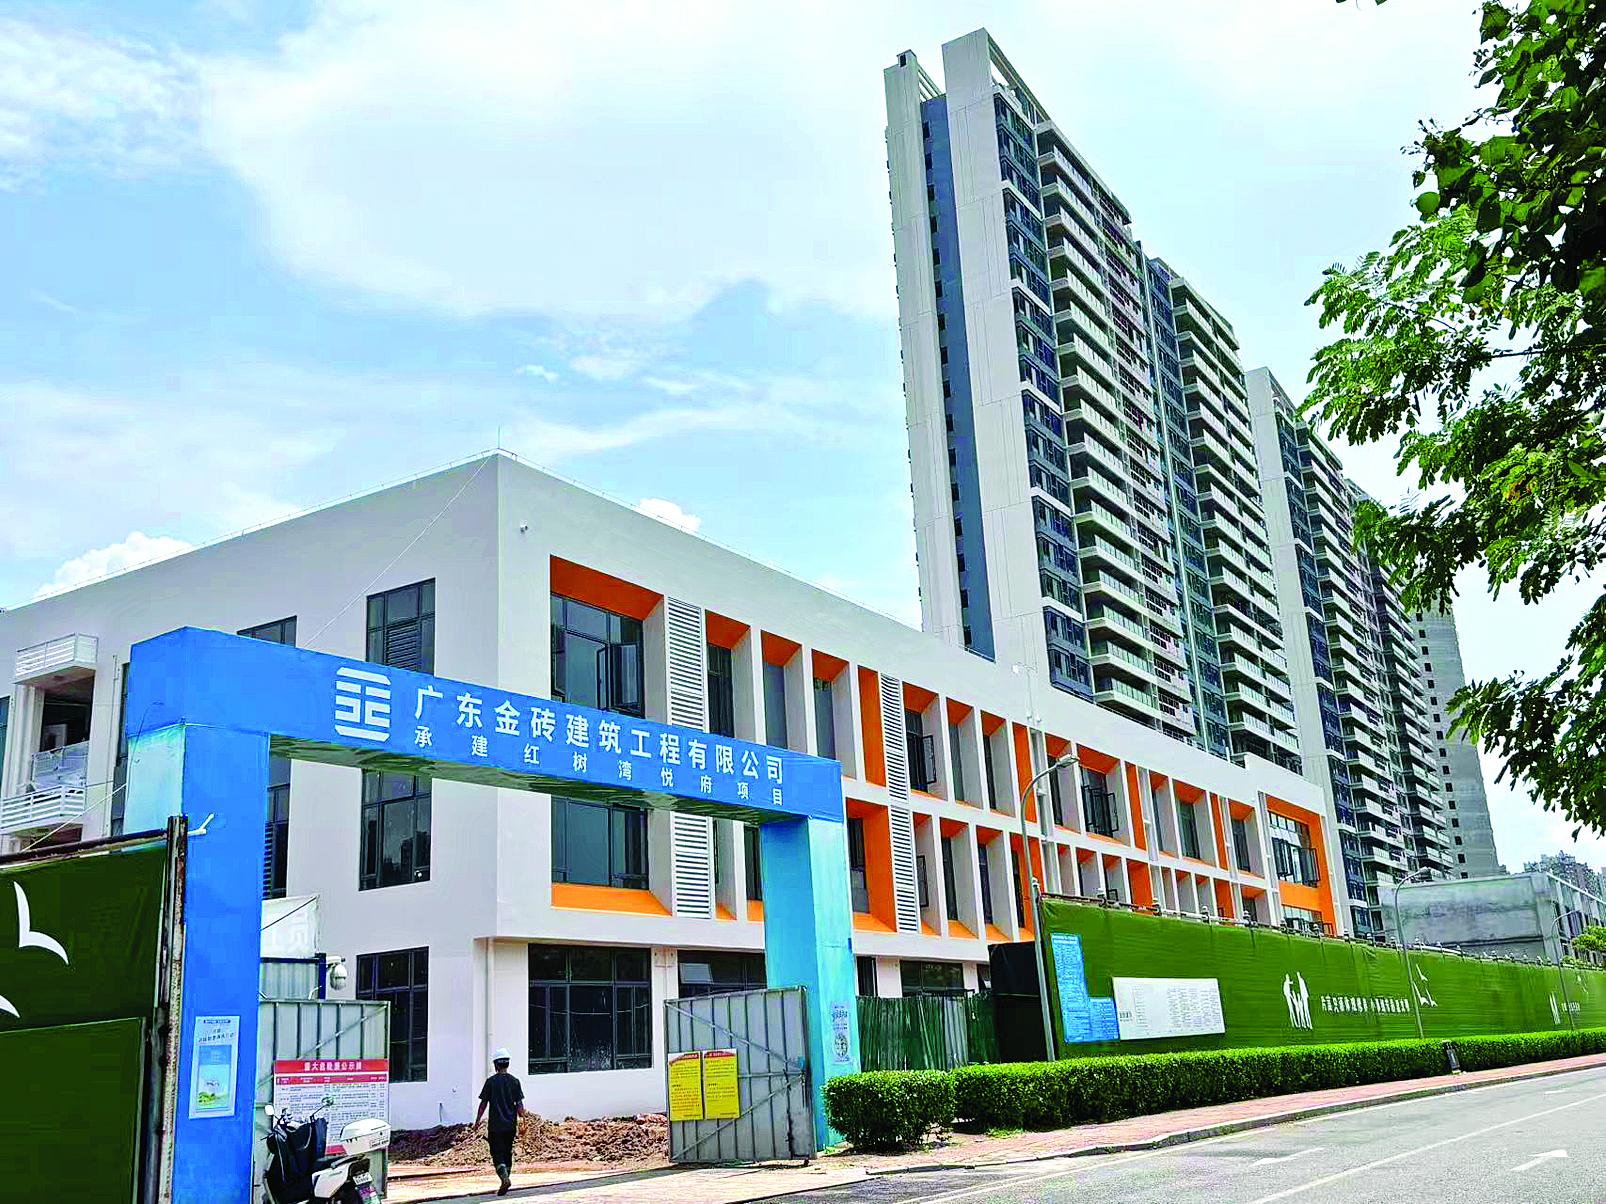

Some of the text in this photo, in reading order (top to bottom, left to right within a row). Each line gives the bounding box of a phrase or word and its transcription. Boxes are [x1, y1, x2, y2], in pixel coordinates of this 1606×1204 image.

[413, 725, 783, 806] 承建红树湾悦府项目
[414, 685, 784, 784] 广东金砖建筑工程有限公司
